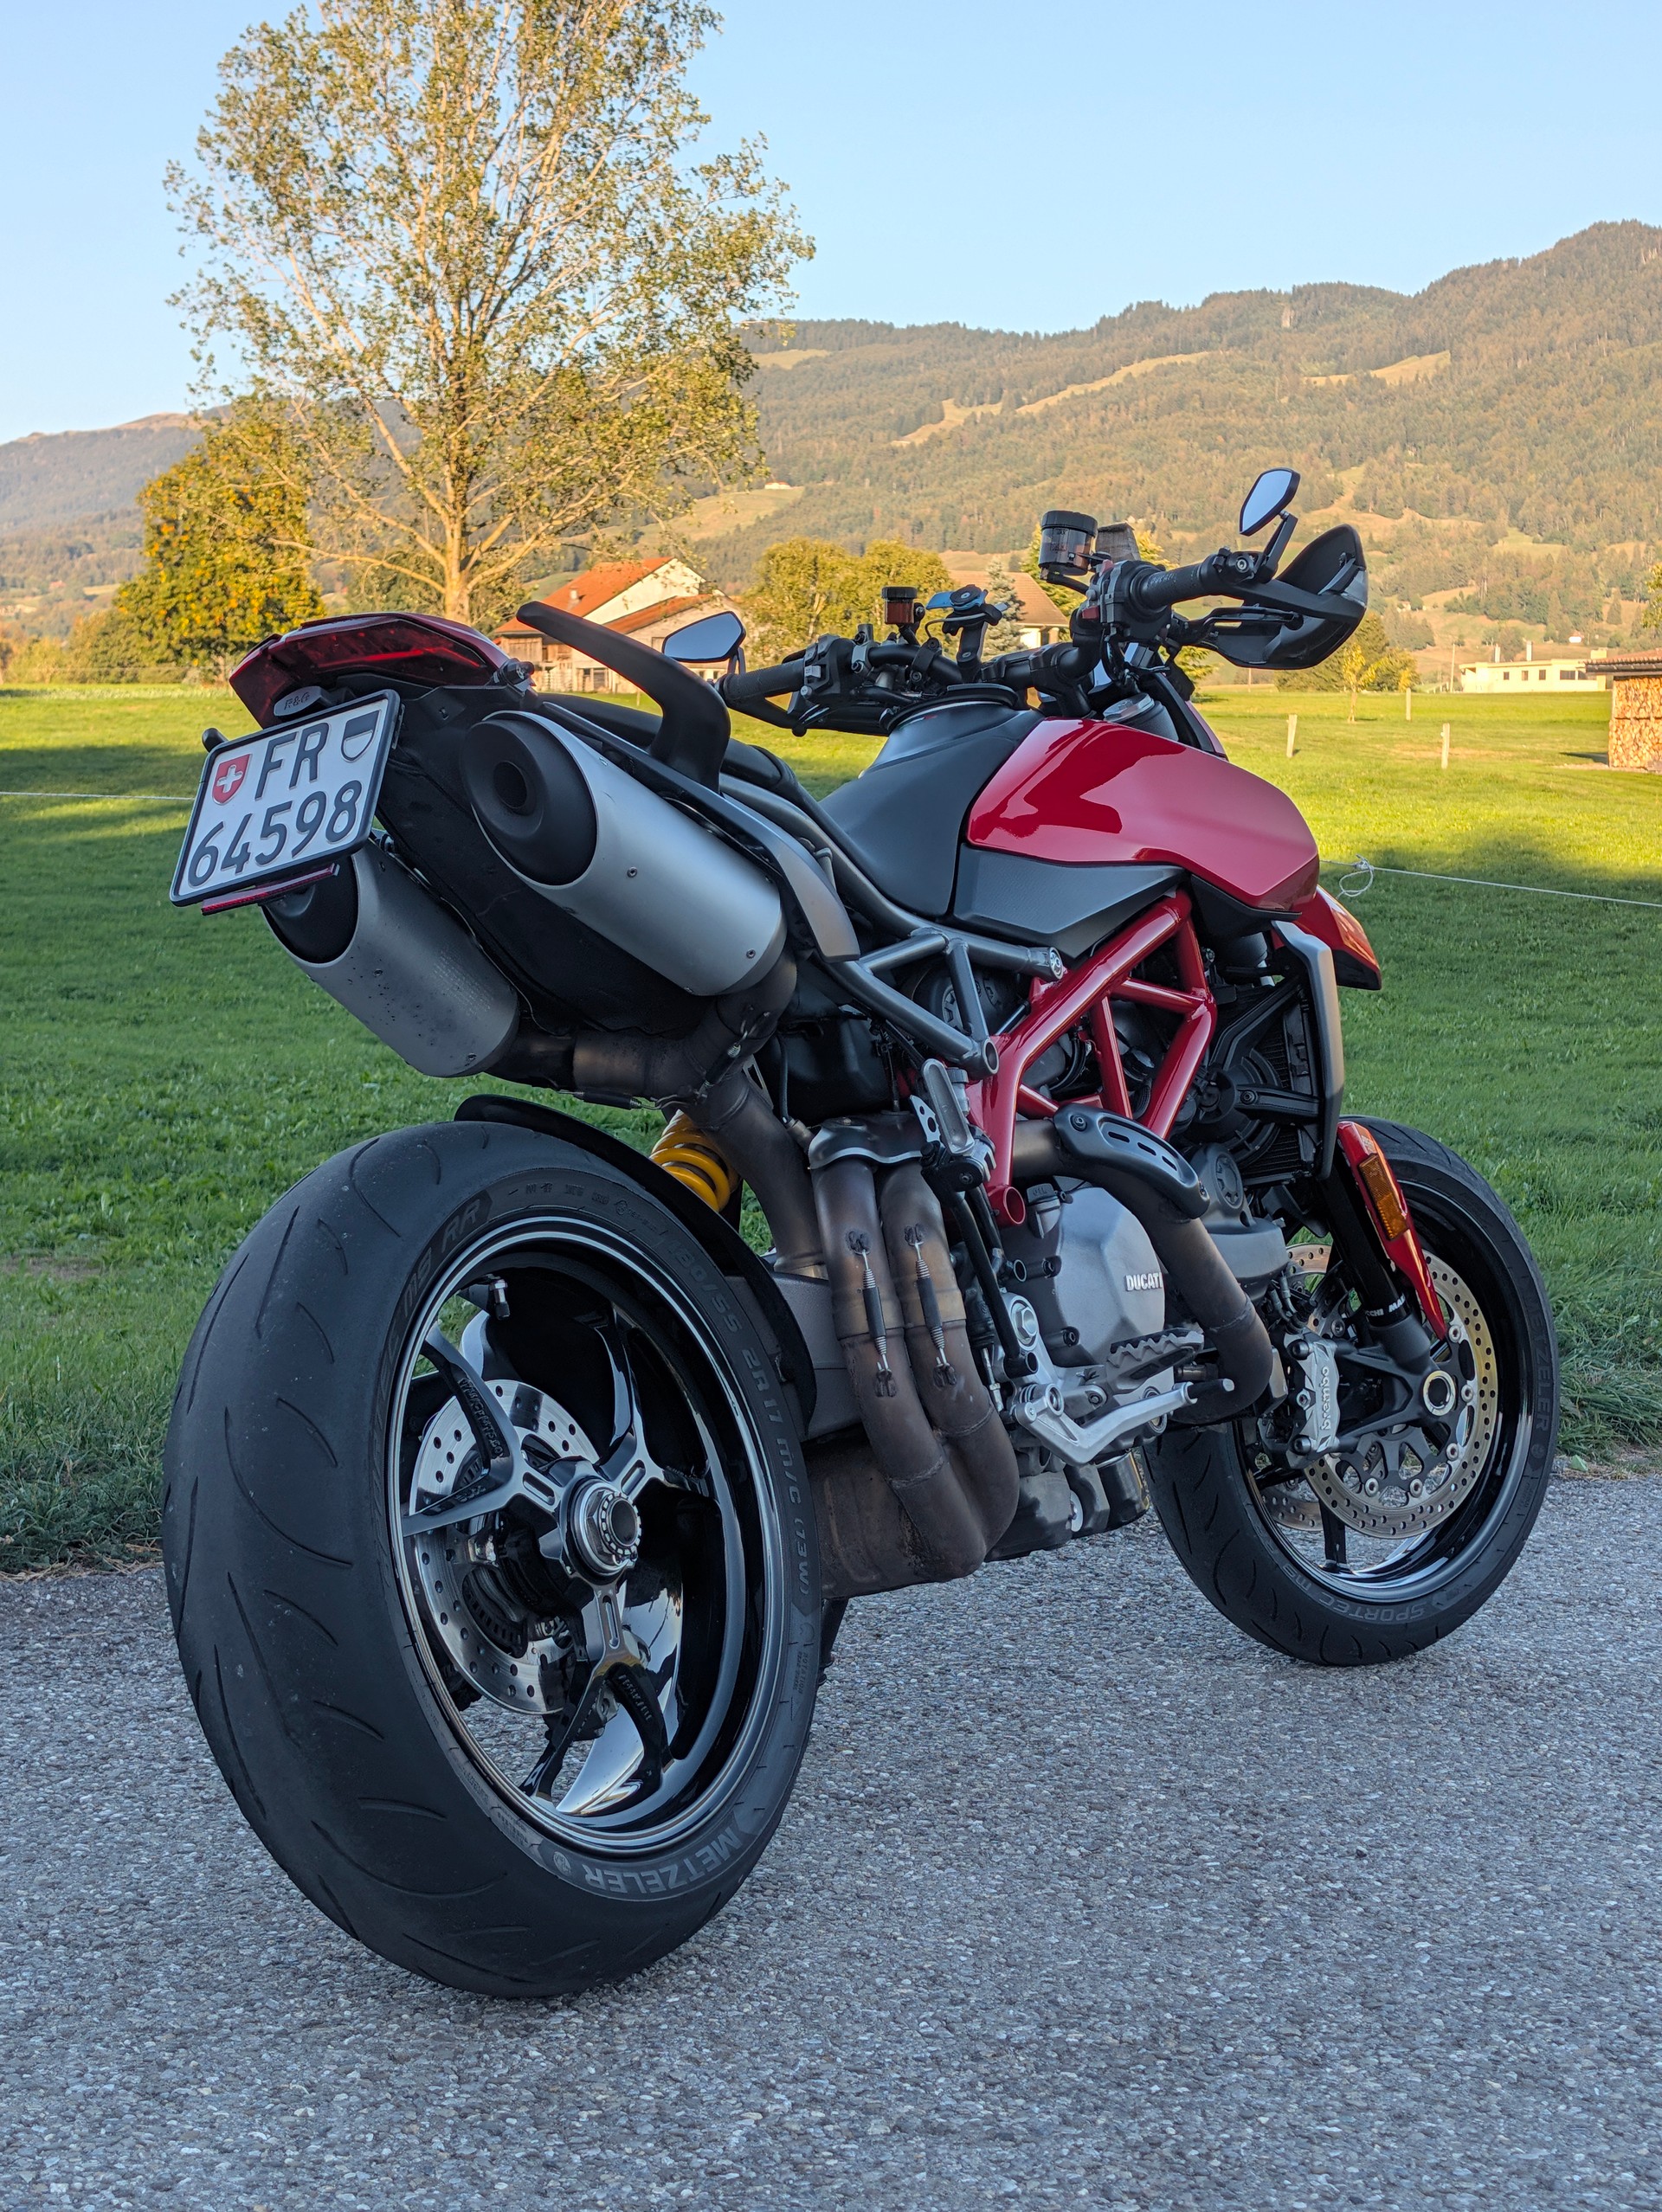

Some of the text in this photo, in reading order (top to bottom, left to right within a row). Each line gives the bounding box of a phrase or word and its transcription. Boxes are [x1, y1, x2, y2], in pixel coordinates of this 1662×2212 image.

[284, 692, 310, 710] R&G
[254, 722, 330, 801] FR
[187, 780, 363, 888] 64598
[441, 1199, 480, 1253] RR
[1125, 1271, 1163, 1291] DUCATI
[1524, 1295, 1552, 1432] METZELER
[1319, 1366, 1331, 1431] brembo
[741, 1347, 770, 1392] ZR
[763, 1399, 783, 1424] 17
[776, 1437, 802, 1505] M/C
[794, 1517, 810, 1596] (73W)
[1318, 1591, 1427, 1622] SPORTEC
[582, 1826, 744, 1894] METZELER
